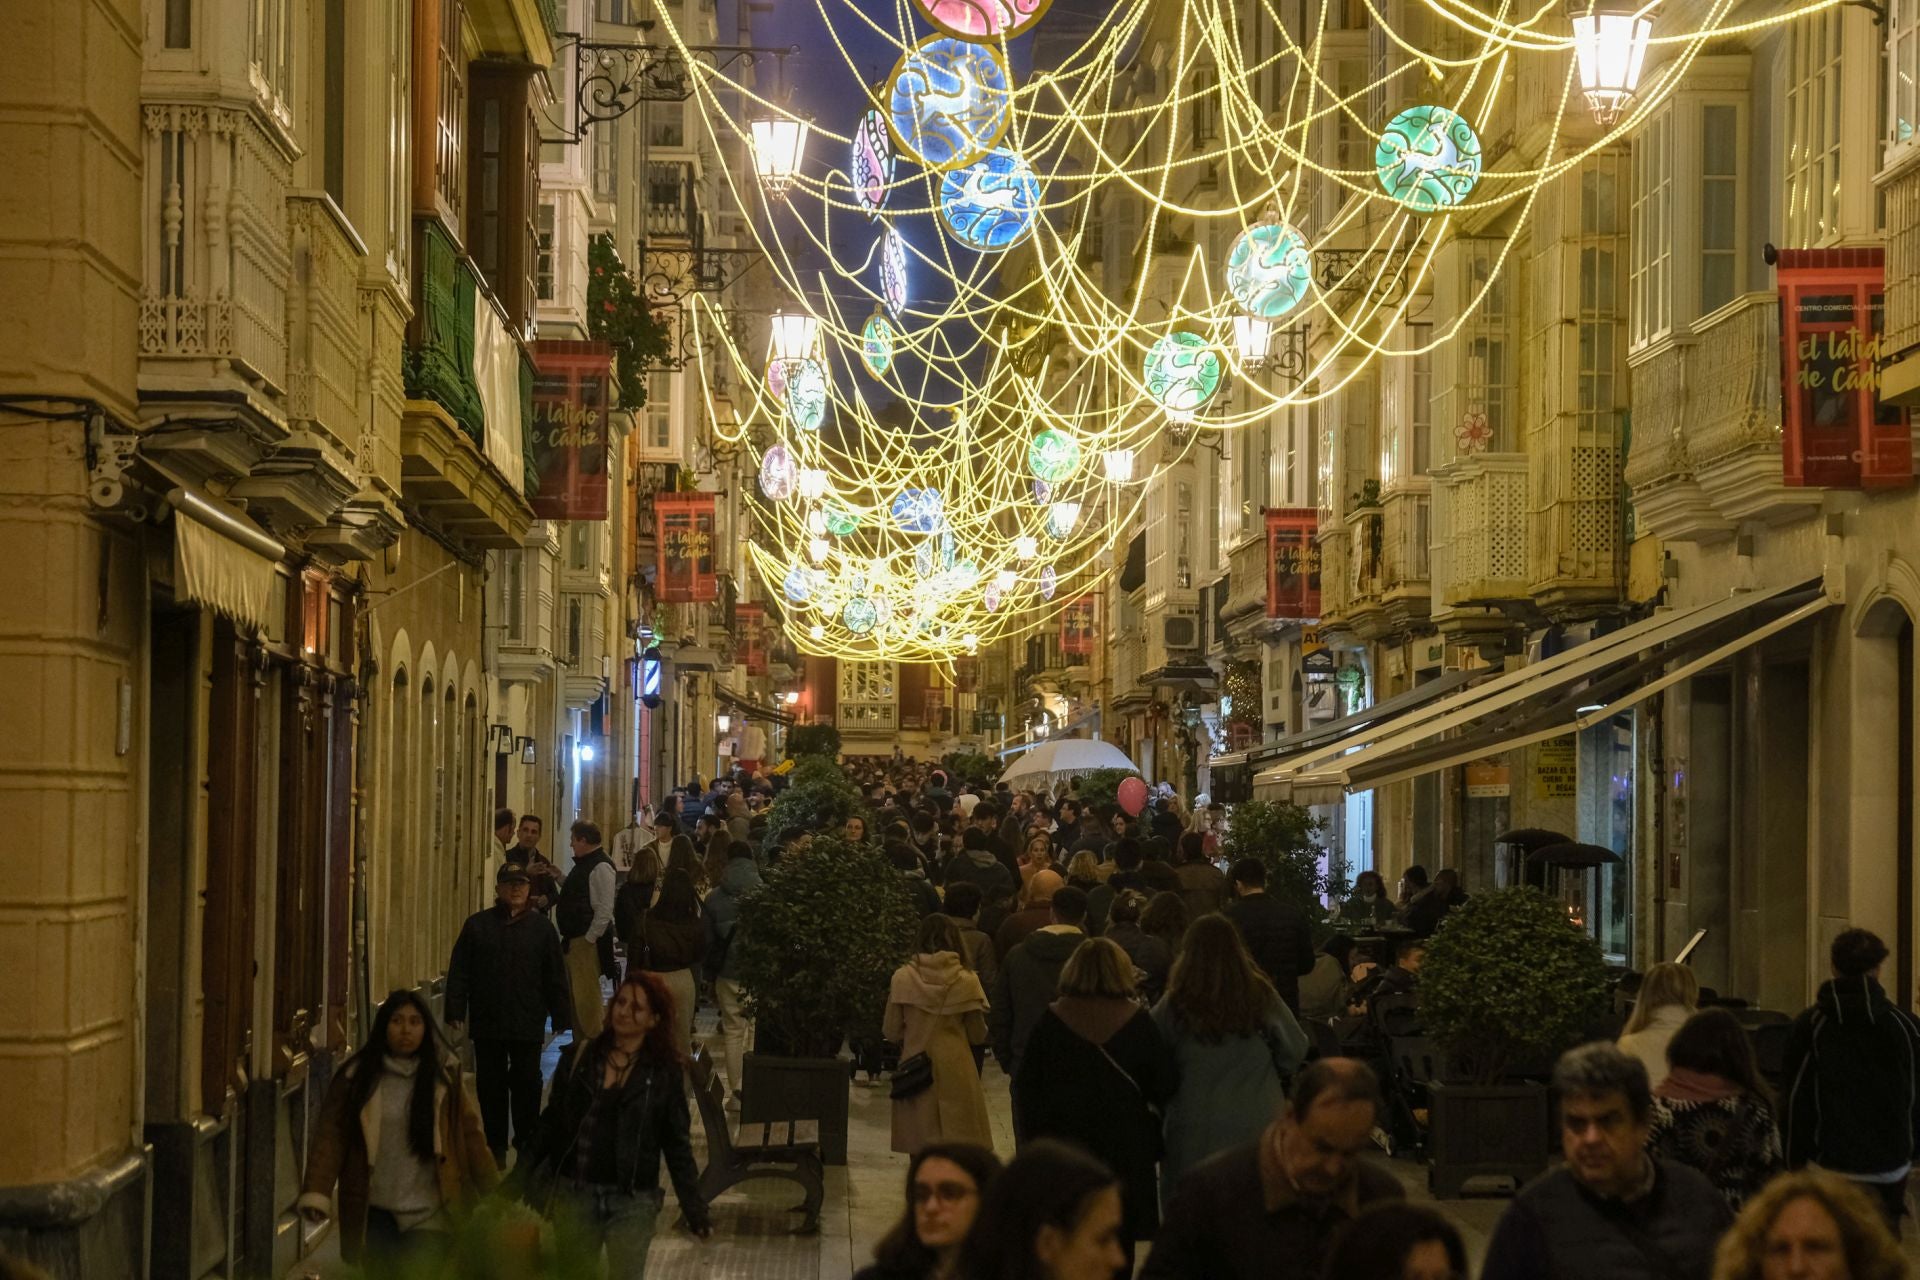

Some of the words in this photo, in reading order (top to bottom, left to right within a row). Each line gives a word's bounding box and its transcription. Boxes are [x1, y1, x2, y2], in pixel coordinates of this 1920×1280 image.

[1798, 333, 1821, 361] El
[1828, 327, 1884, 362] latid
[1794, 363, 1826, 390] de
[1832, 362, 1882, 393] Cádi
[547, 398, 599, 426] latido
[548, 426, 599, 448] Cádiz
